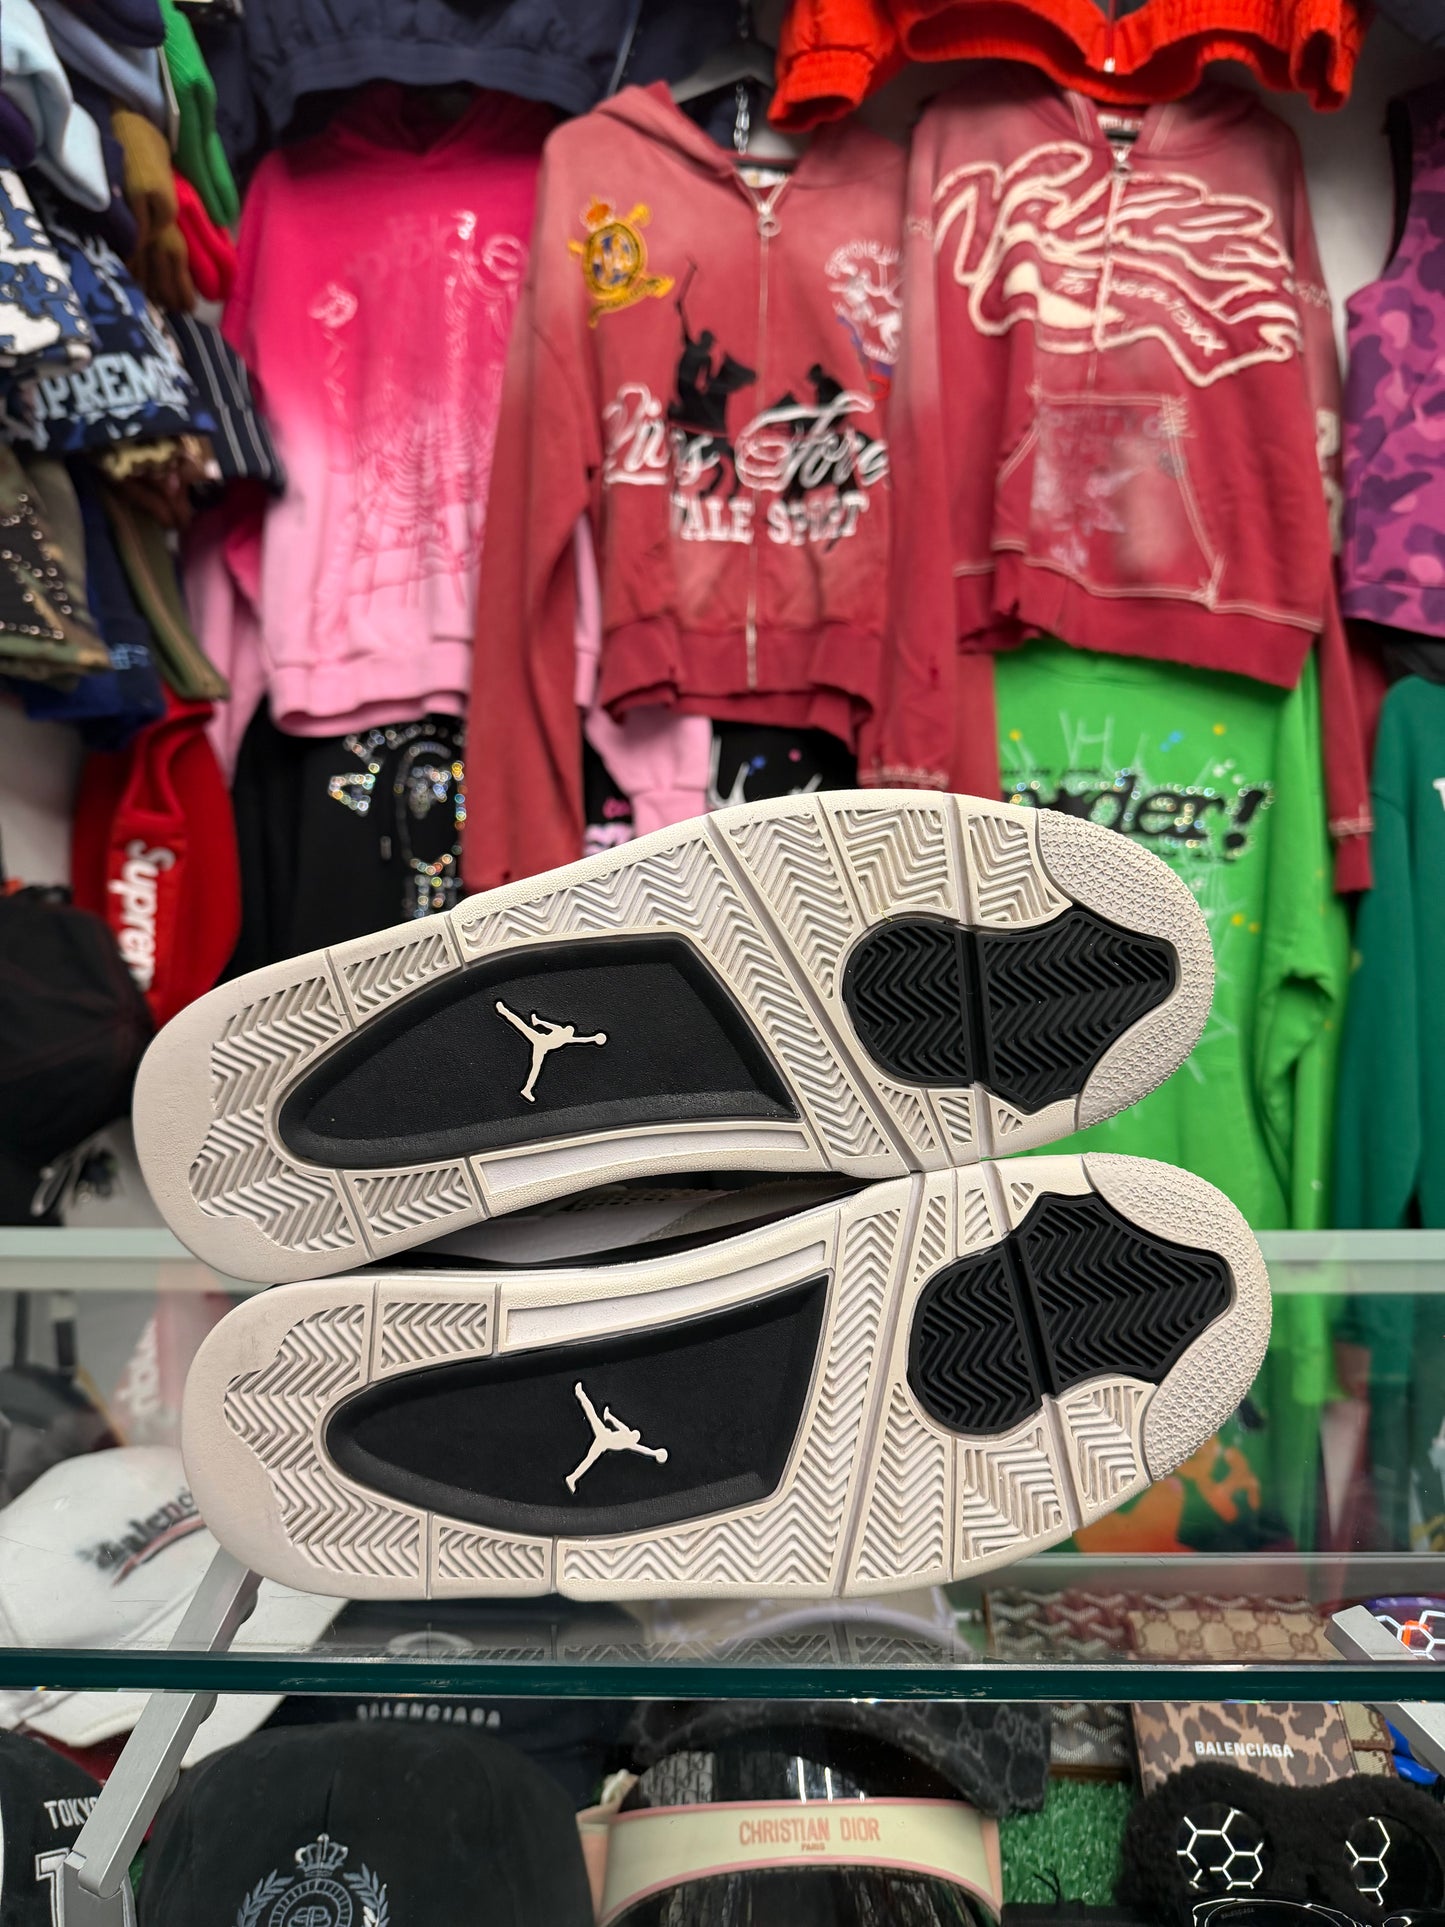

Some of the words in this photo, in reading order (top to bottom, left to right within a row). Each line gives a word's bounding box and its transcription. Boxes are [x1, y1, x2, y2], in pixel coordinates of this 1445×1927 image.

[1194, 1740, 1295, 1758] BALENCIAGA
[739, 1817, 830, 1845] CHRISTIAN
[840, 1816, 880, 1841] DIOR
[801, 1842, 825, 1851] PARIS
